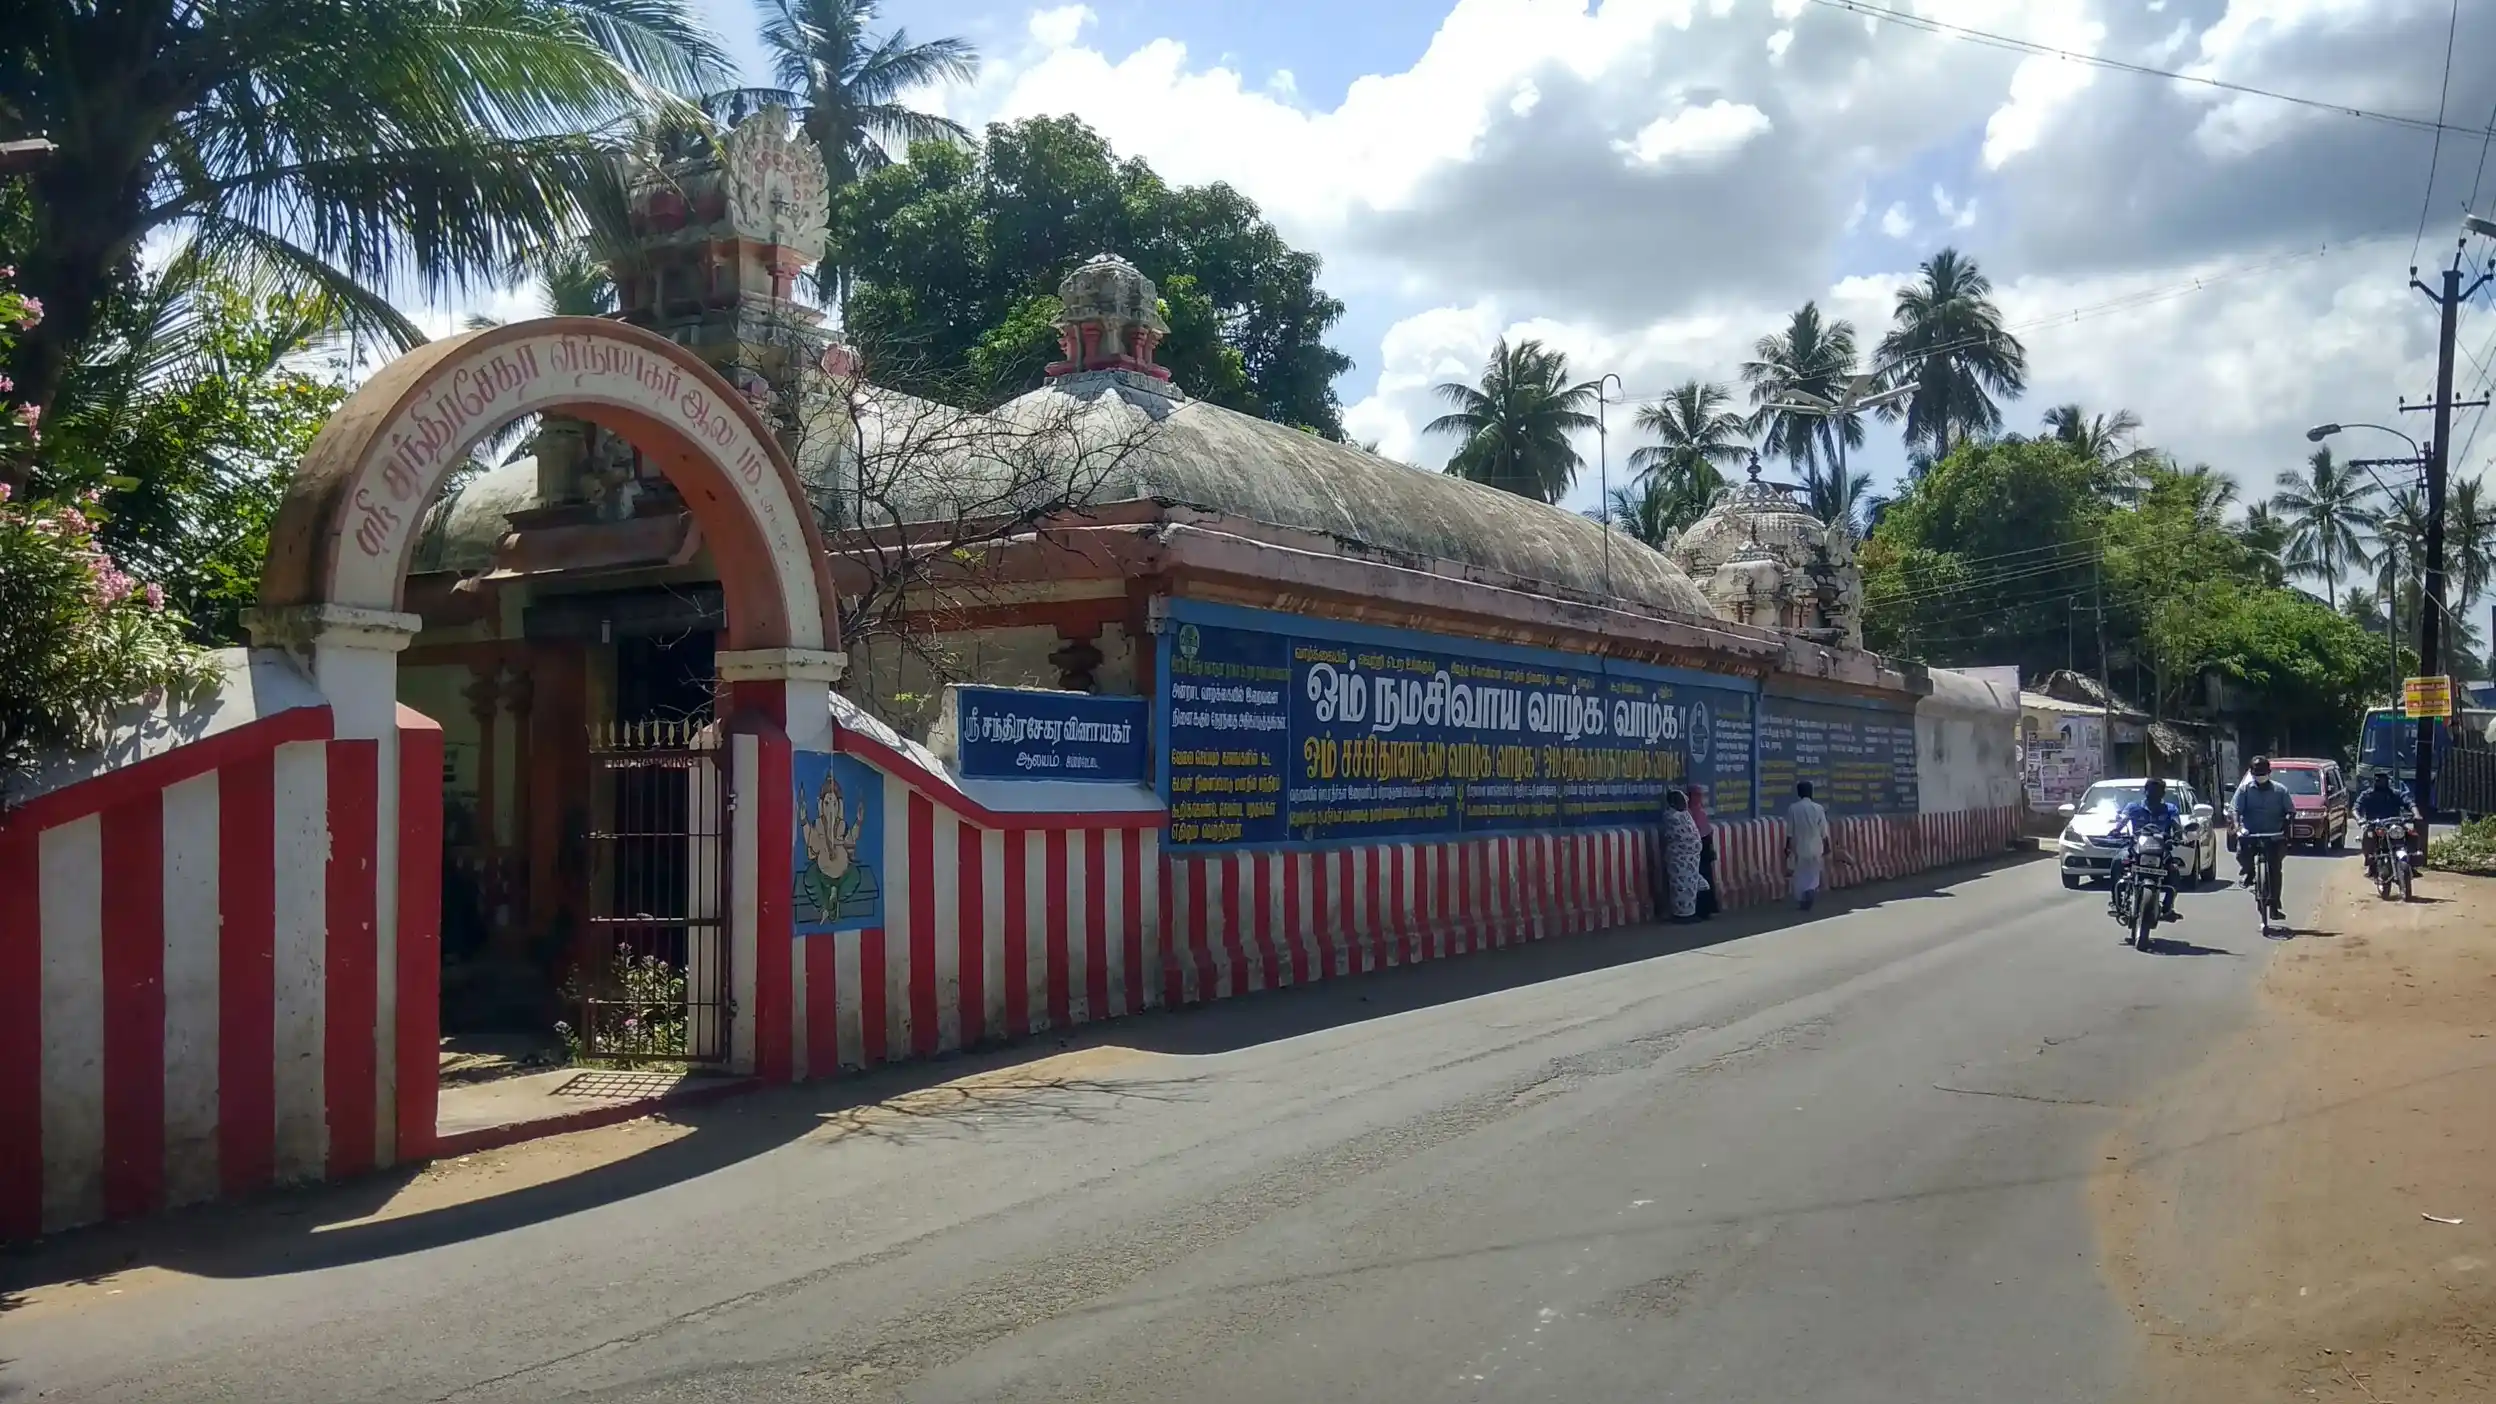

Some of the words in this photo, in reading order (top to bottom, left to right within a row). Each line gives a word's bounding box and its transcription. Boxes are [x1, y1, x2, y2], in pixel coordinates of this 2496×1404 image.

[964, 706, 980, 743] ஸ்ரீ
[981, 711, 1062, 746] சந்திரசேகர
[1063, 715, 1132, 744] வினாயகர்
[1372, 670, 1521, 733] நமசிவாய
[1527, 683, 1609, 743] வாழ்க!
[1614, 693, 1686, 745] வாழ்க!!
[1341, 734, 1446, 784] சச்சிதானந்தம்
